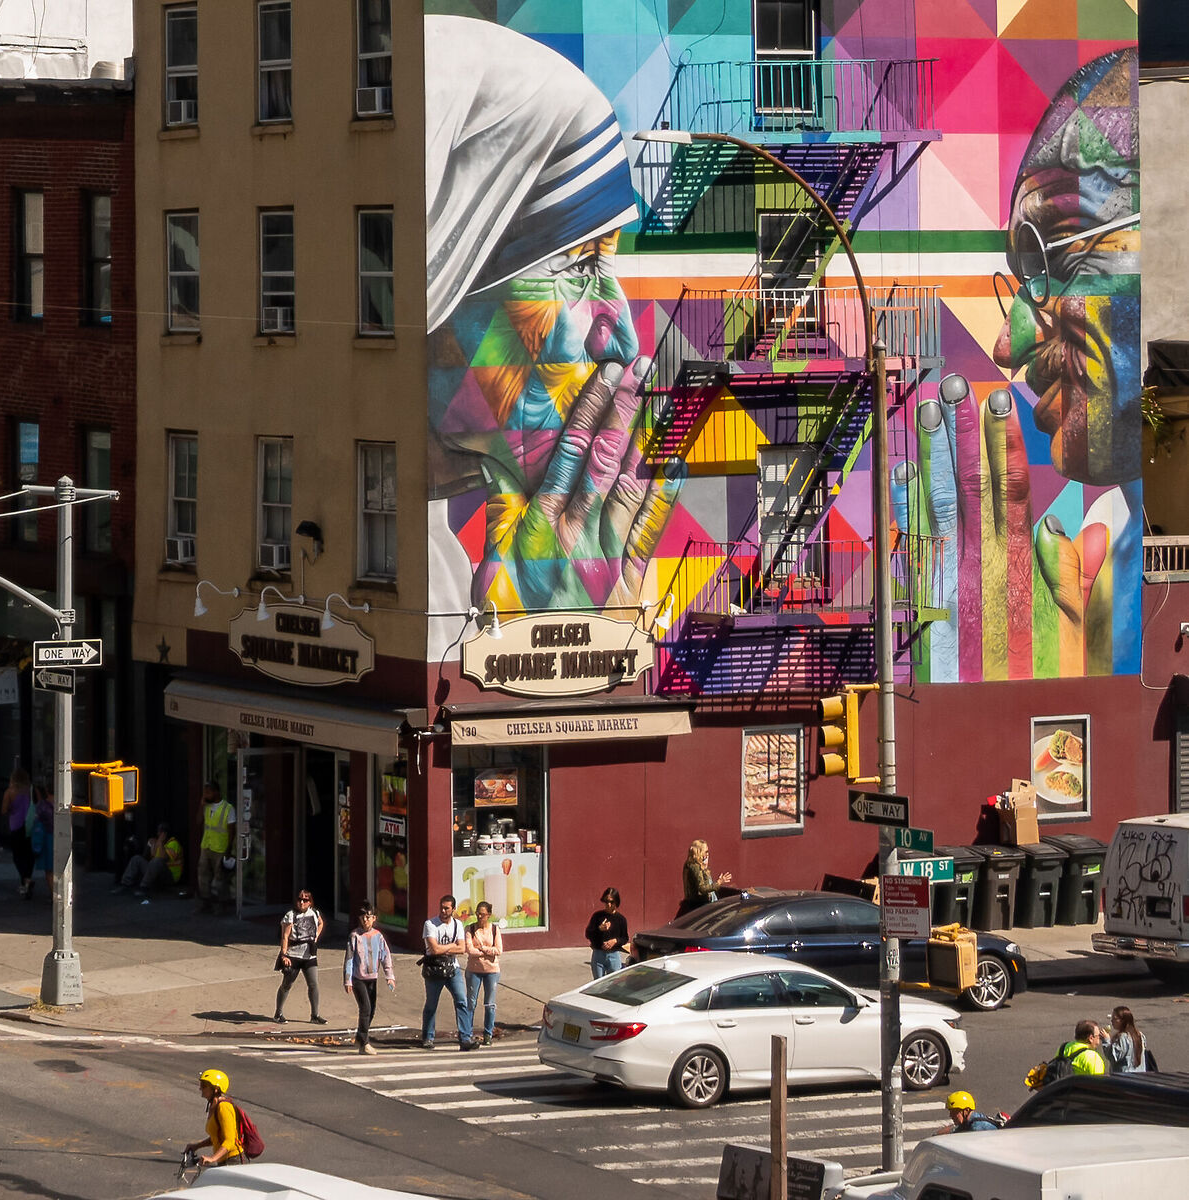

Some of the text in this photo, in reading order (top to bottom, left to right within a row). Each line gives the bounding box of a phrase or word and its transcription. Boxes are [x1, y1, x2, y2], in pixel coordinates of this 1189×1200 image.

[276, 612, 320, 638] CHELSEA
[531, 623, 591, 648] CHELSEA
[44, 648, 91, 659] ONE WAY
[241, 634, 359, 674] SQUARE MARKET
[485, 650, 638, 684] SQUARE MARKET
[41, 672, 71, 686] ONE WAY
[240, 712, 314, 736] CHELSEA SQUARE MARKET
[461, 726, 477, 737] 130
[507, 718, 639, 736] CHELSEA SQUARE MARKET
[857, 801, 902, 818] ONE WAY
[384, 822, 400, 835] ATM
[900, 829, 928, 848] 10 AV
[903, 860, 950, 880] W 18 ST
